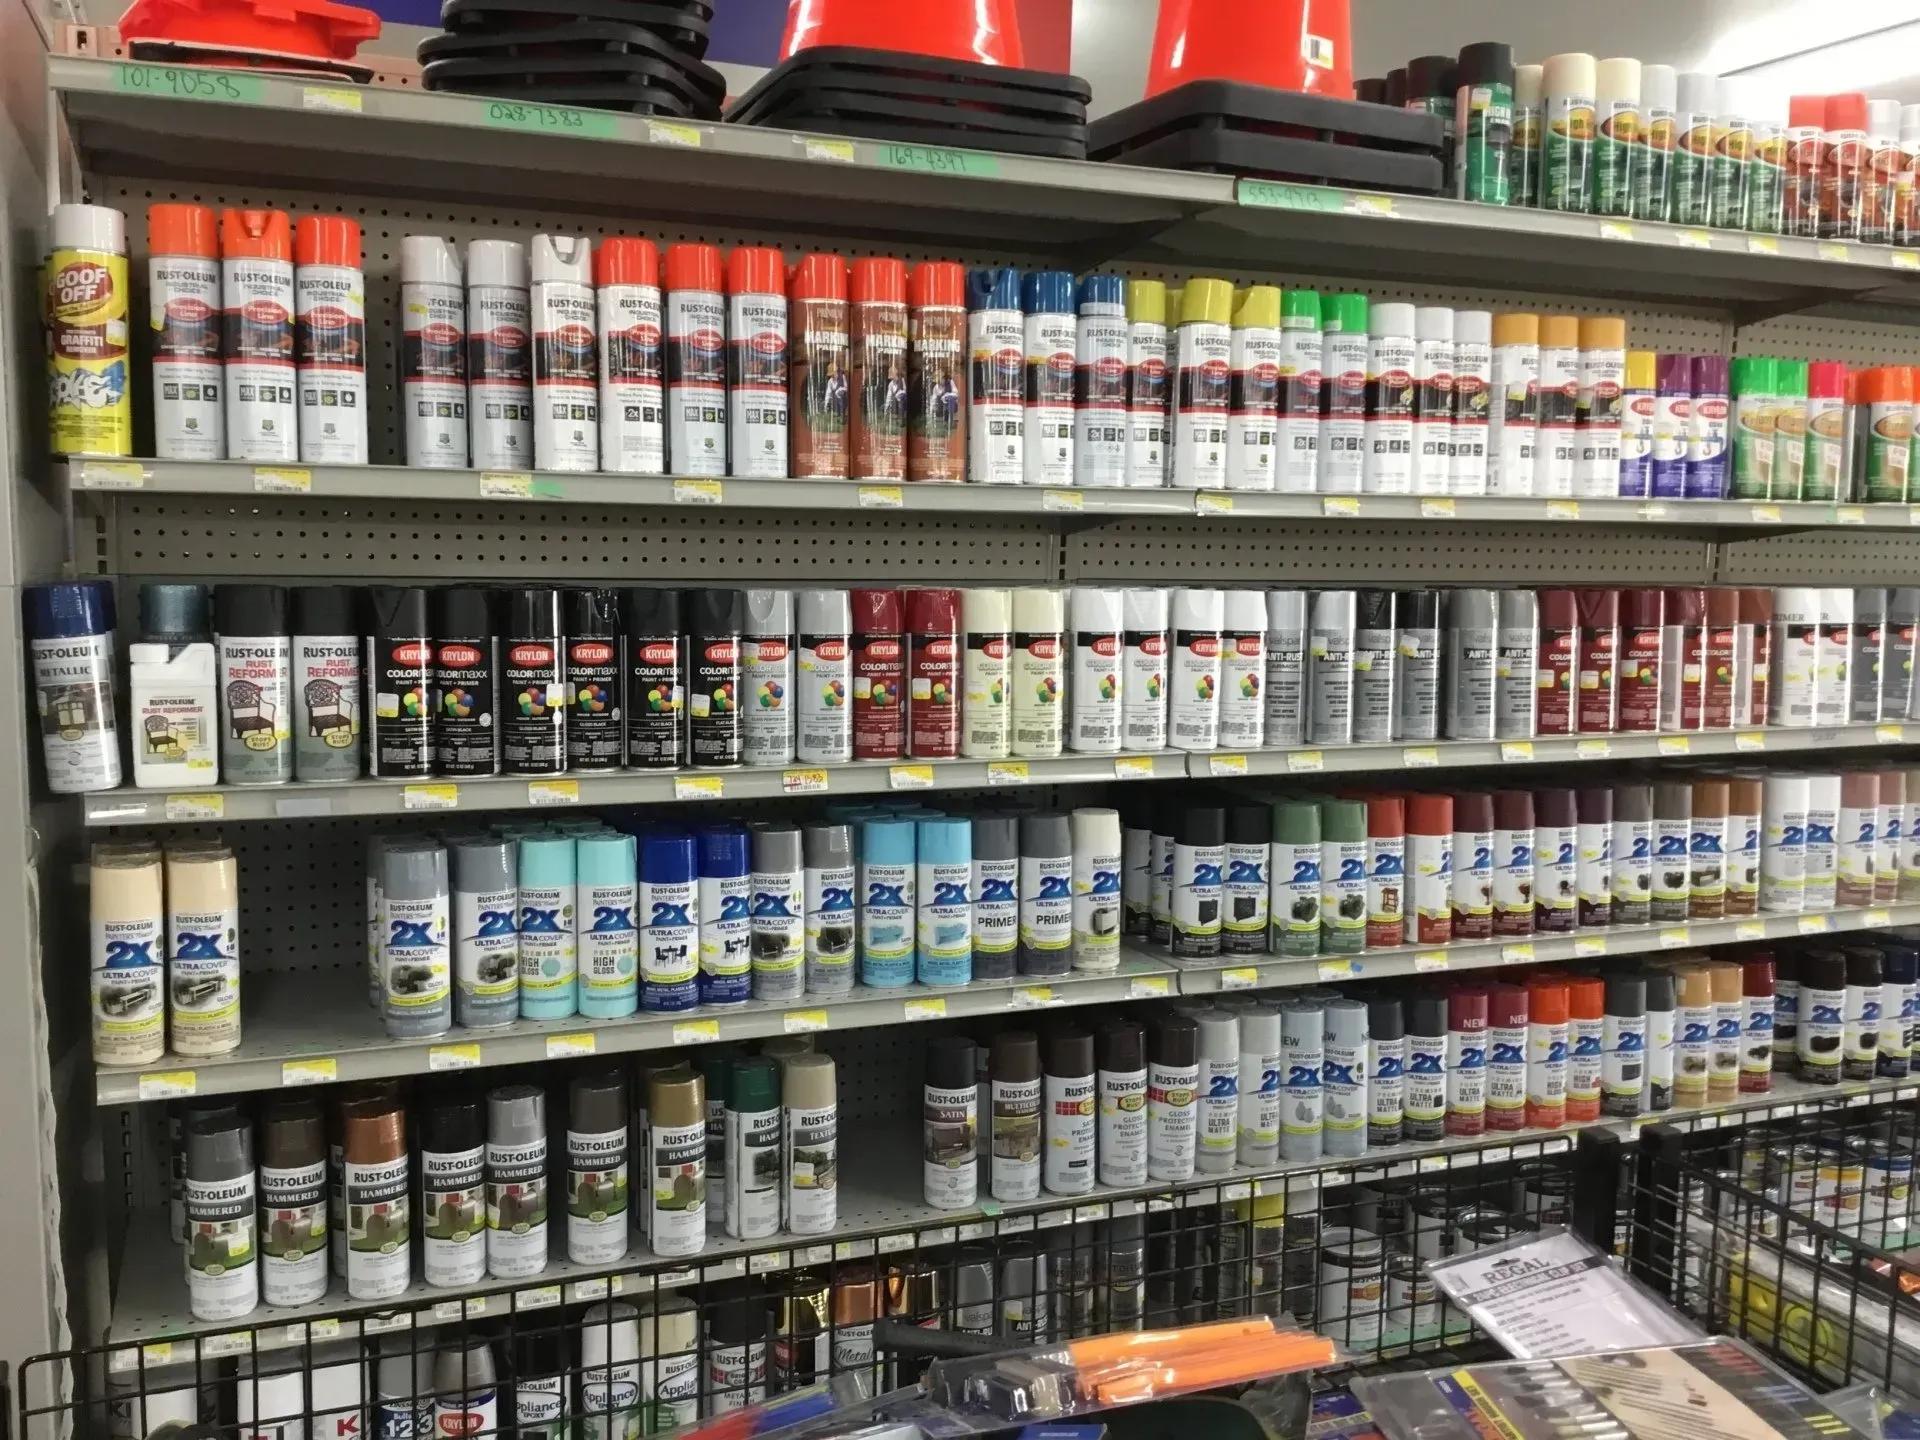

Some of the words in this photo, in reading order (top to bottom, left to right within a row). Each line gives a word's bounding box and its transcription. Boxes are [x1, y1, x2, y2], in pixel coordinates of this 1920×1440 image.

[122, 67, 240, 97] 101-9058
[55, 267, 106, 288] GOOF
[157, 270, 216, 283] RUST-OLEUM
[234, 272, 290, 286] RUST-OLEUM
[60, 286, 98, 304] OFF
[61, 335, 103, 347] GRAFFITI
[914, 339, 960, 352] MARKING
[442, 649, 474, 662] KRYLON
[516, 649, 548, 661] KRYLON
[576, 648, 608, 660] KRYLON
[1266, 652, 1304, 662] ANTI-RUST
[246, 660, 272, 668] RUST
[326, 659, 350, 667] RUST
[229, 667, 287, 678] REFORMER
[1658, 836, 1687, 854] 2X
[1690, 833, 1724, 852] 2X
[1294, 860, 1321, 882] 2X
[1375, 853, 1404, 874] 2X
[1194, 863, 1223, 887] 2X
[1229, 861, 1266, 883] 2X
[981, 878, 1016, 900] 2X
[1040, 877, 1072, 899] 2X
[1093, 872, 1121, 893] 2X
[822, 887, 854, 910] 2X
[869, 883, 905, 904] 2X
[721, 895, 751, 920] 2X
[754, 892, 794, 916] 2X
[479, 911, 516, 936] 2X
[752, 918, 772, 926] ULTRA
[978, 915, 1017, 928] PRIMER
[391, 919, 434, 945] 2X
[519, 934, 538, 942] ULTRA
[590, 933, 614, 942] ULTRA
[649, 928, 672, 936] ULTRA
[176, 932, 222, 958] 2X
[475, 938, 498, 947] ULTRA
[106, 940, 153, 967] 2X
[388, 949, 412, 957] ULTRA
[174, 961, 200, 970] ULTRA
[593, 957, 615, 968] HIGH
[593, 966, 615, 975] GLOSS
[102, 971, 131, 979] ULTRA
[1750, 1011, 1773, 1030] 2X
[1812, 1005, 1842, 1023] 2X
[1464, 1018, 1486, 1028] NEW
[1717, 1020, 1741, 1038] 2X
[1684, 1023, 1710, 1042] 2X
[1618, 1032, 1643, 1050] 2X
[1460, 1048, 1486, 1068] 2X
[1493, 1043, 1526, 1062] 2X
[1379, 1057, 1403, 1077] 2X
[1411, 1053, 1443, 1073] 2X
[1289, 1066, 1319, 1086] 2X
[1323, 1061, 1354, 1083] 2X
[1210, 1076, 1237, 1096] 2X
[928, 1092, 976, 1105] RUST-OLEUM
[1410, 1094, 1432, 1102] ULTRA
[940, 1109, 965, 1120] SATIN
[570, 1136, 624, 1151] RUST-OLEUM
[490, 1147, 547, 1163] RUST-OLEUM
[574, 1154, 621, 1166] HAMMERED
[494, 1164, 543, 1178] HAMMERED
[263, 1172, 323, 1187] RUST-OLEUM
[434, 1173, 482, 1187] HAMMERED
[267, 1191, 319, 1203] HAMMERED
[189, 1205, 241, 1215] HAMMERED
[1481, 1257, 1550, 1284] REGAL
